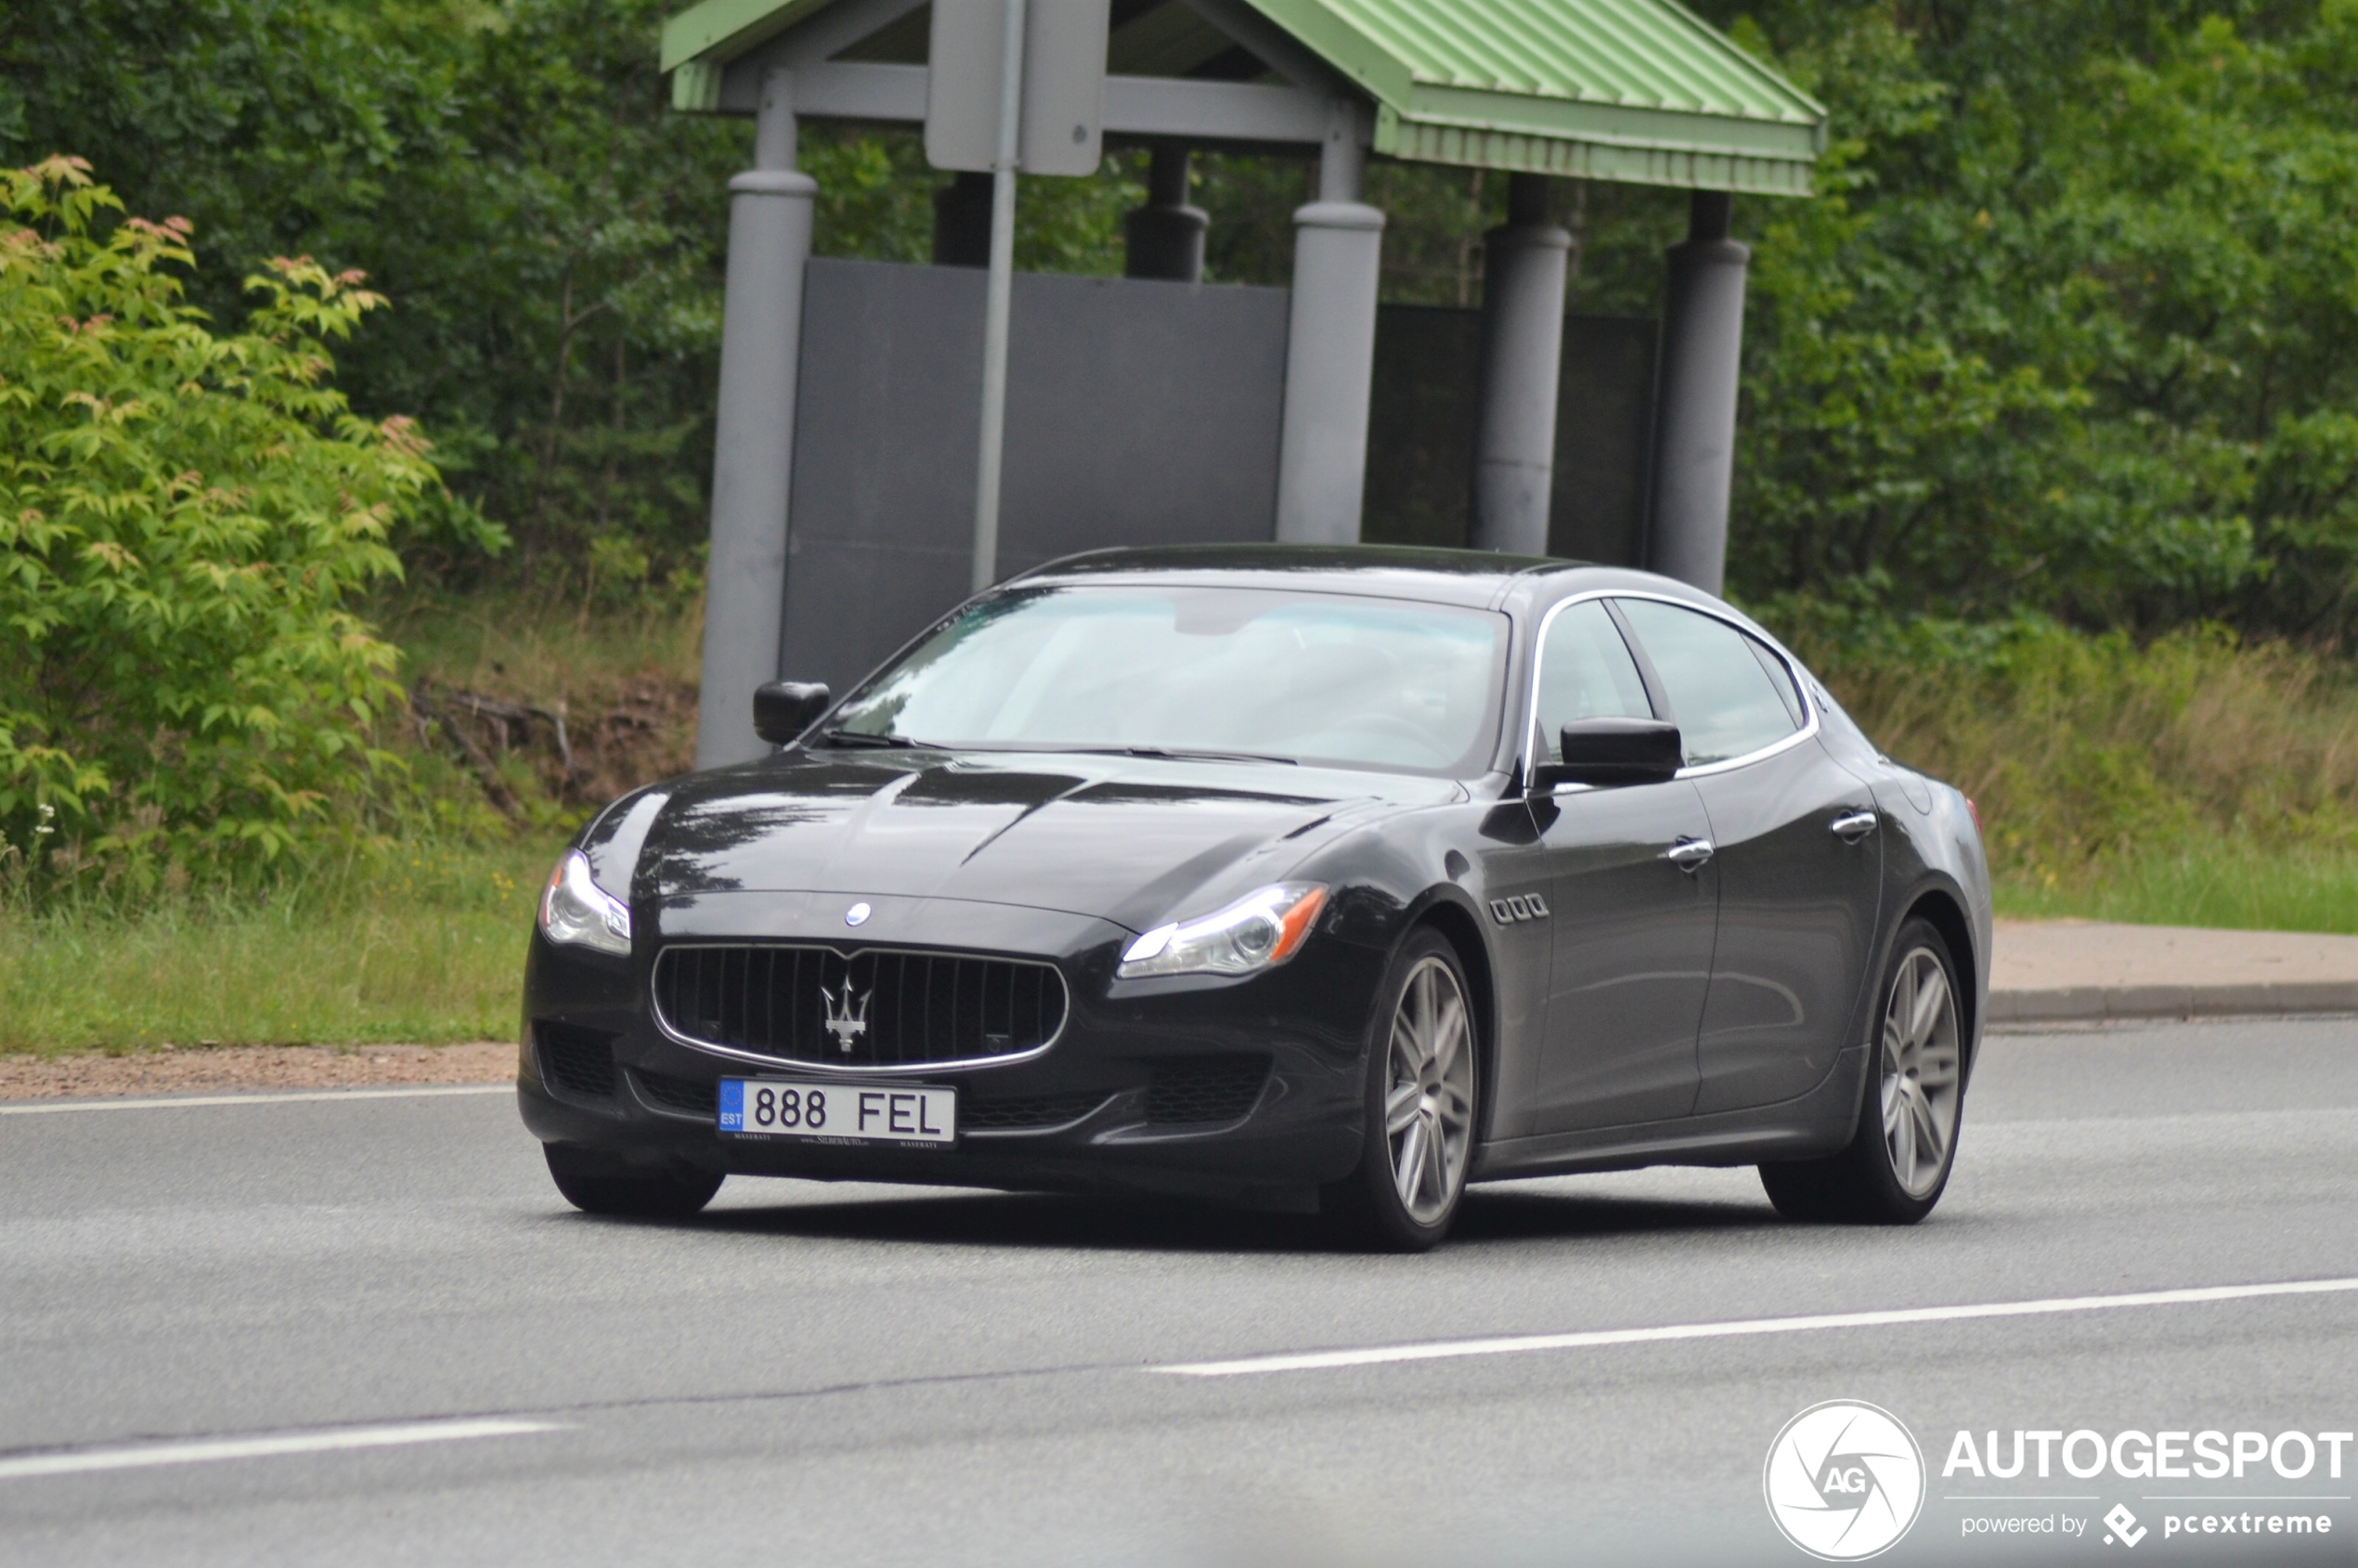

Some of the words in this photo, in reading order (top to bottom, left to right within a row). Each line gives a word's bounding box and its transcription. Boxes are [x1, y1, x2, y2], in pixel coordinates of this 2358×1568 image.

[755, 1087, 826, 1129] 888
[858, 1092, 941, 1134] FEL
[720, 1113, 743, 1125] EST
[733, 1133, 771, 1141] MASERATI
[900, 1141, 938, 1149] MASERATI
